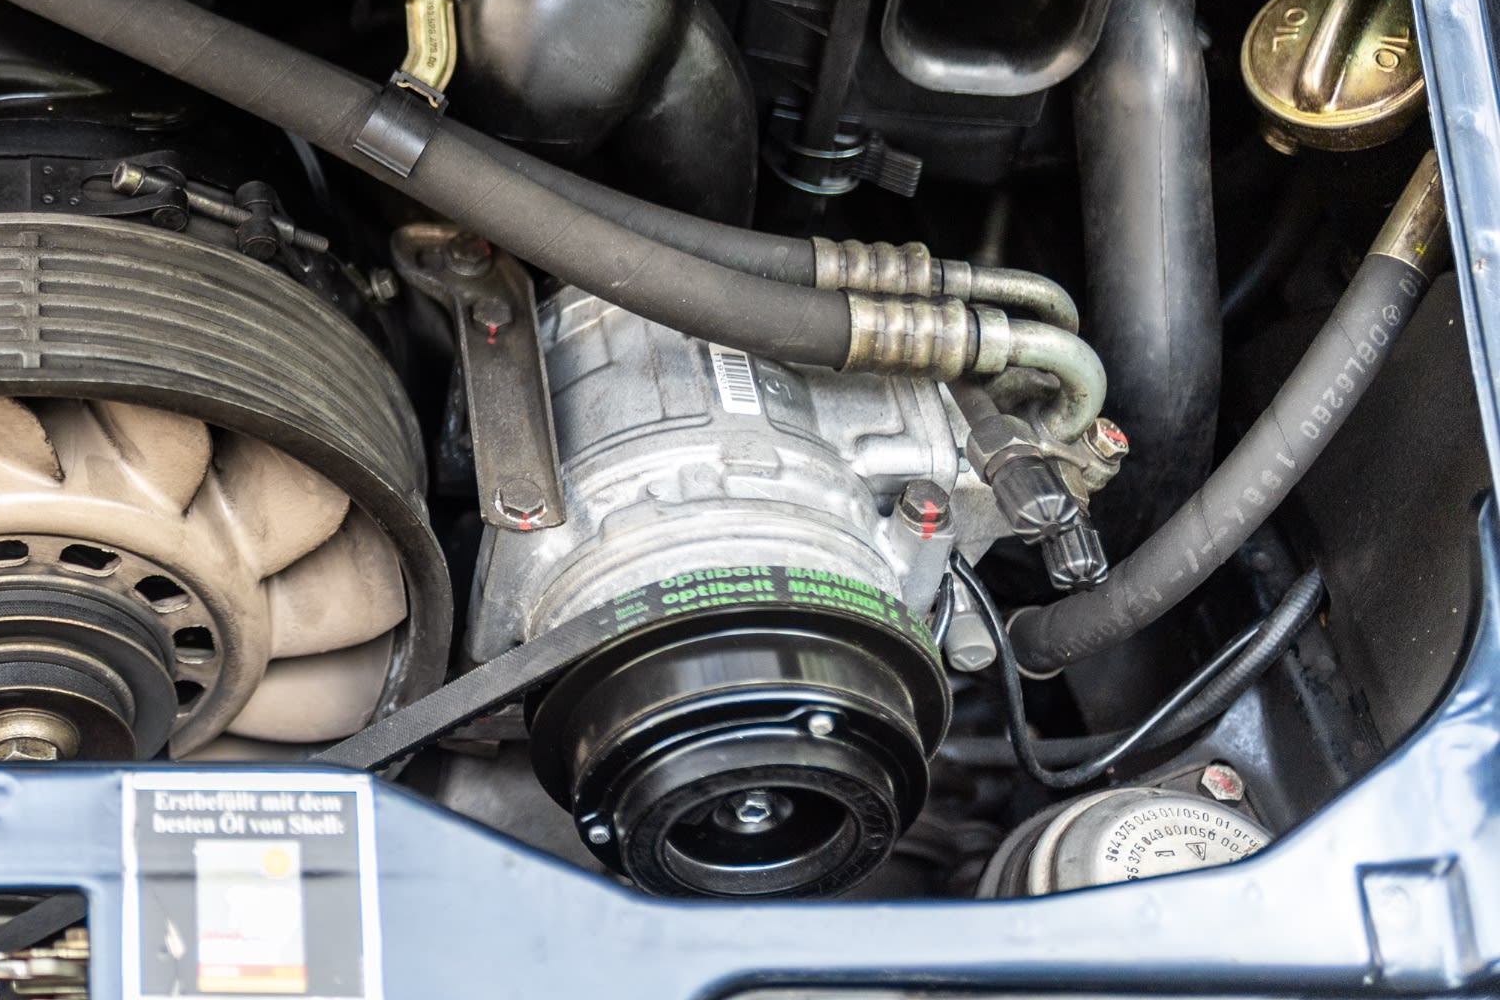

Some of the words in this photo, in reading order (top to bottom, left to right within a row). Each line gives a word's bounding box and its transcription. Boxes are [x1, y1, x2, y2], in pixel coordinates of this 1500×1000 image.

[1272, 8, 1308, 52] OIL
[1372, 27, 1409, 72] OIL
[658, 566, 773, 588] optibelt
[661, 579, 776, 604] optibelt
[788, 580, 885, 614] MARATHON
[153, 790, 257, 812] Erstbefüllt
[261, 792, 295, 812] mit
[299, 792, 342, 812] dem
[152, 812, 216, 834] besten
[218, 811, 246, 834] Öl
[250, 817, 284, 834] von
[1114, 820, 1136, 840] 375
[1133, 809, 1158, 825] 049
[1128, 843, 1146, 864] 375
